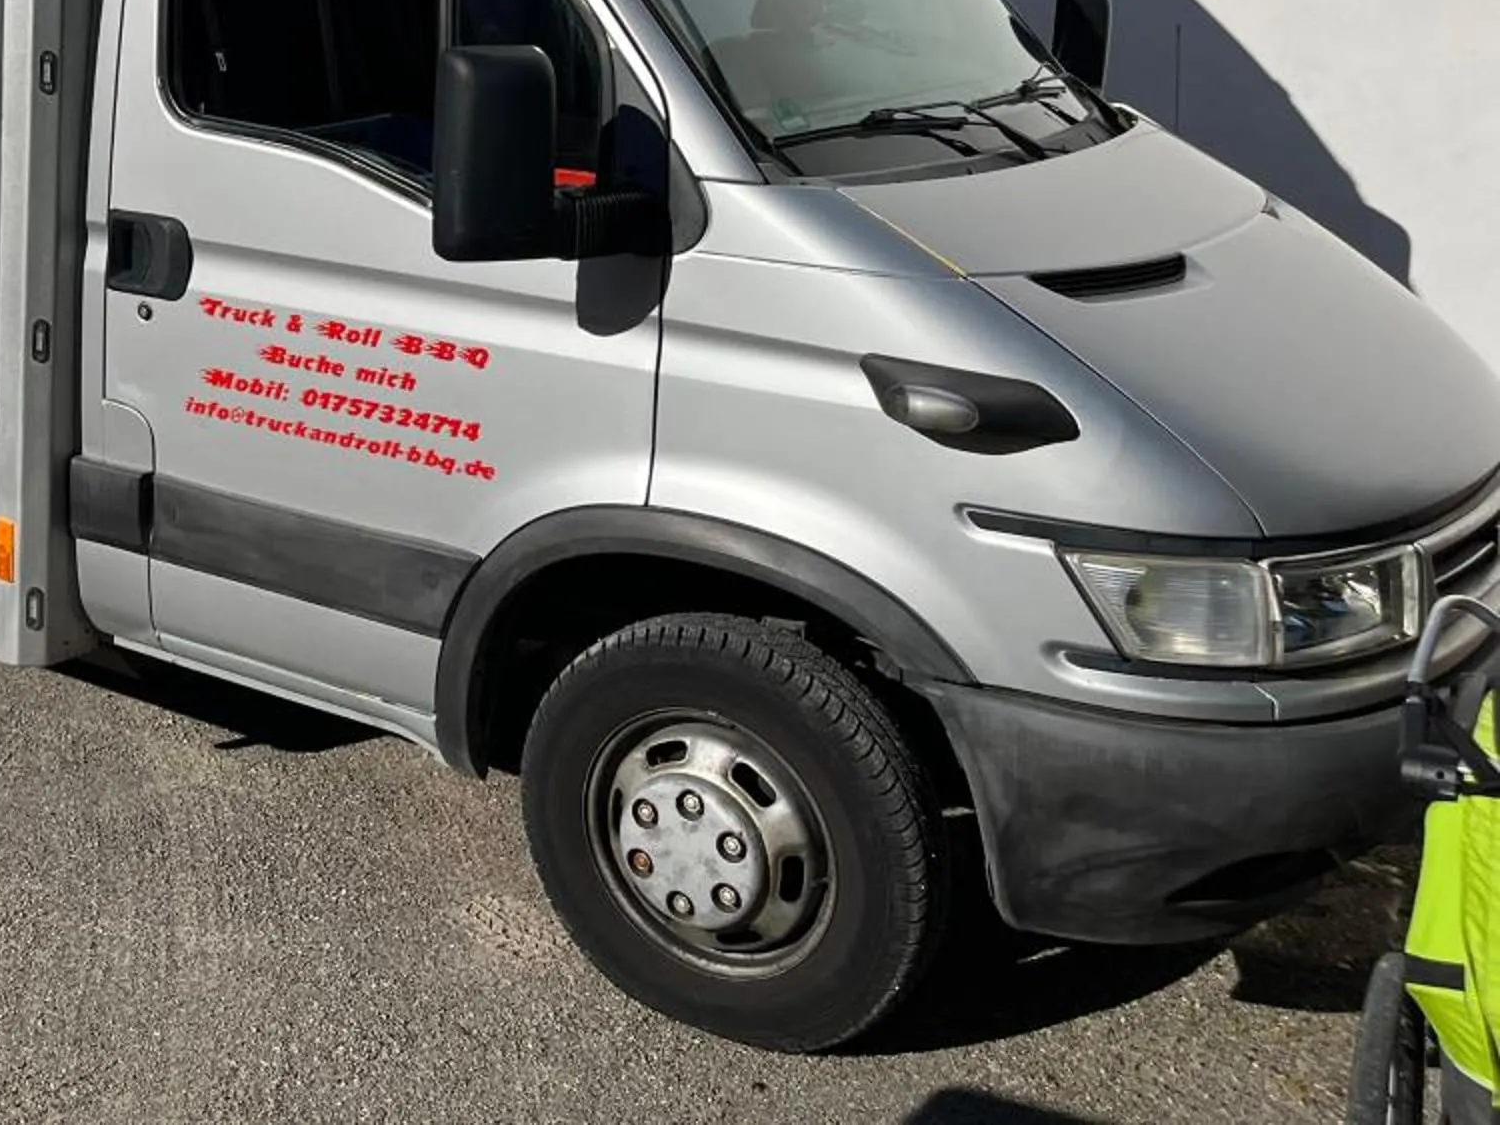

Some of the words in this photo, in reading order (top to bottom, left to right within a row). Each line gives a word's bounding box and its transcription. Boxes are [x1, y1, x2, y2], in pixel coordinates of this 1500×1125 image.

[198, 296, 276, 328] Truck
[286, 314, 302, 333] &
[313, 320, 382, 348] Roll
[201, 368, 289, 402] Mobil:
[259, 345, 345, 378] Buche
[356, 366, 417, 392] mich
[185, 396, 496, 481] info@truckandroll-bbq.de
